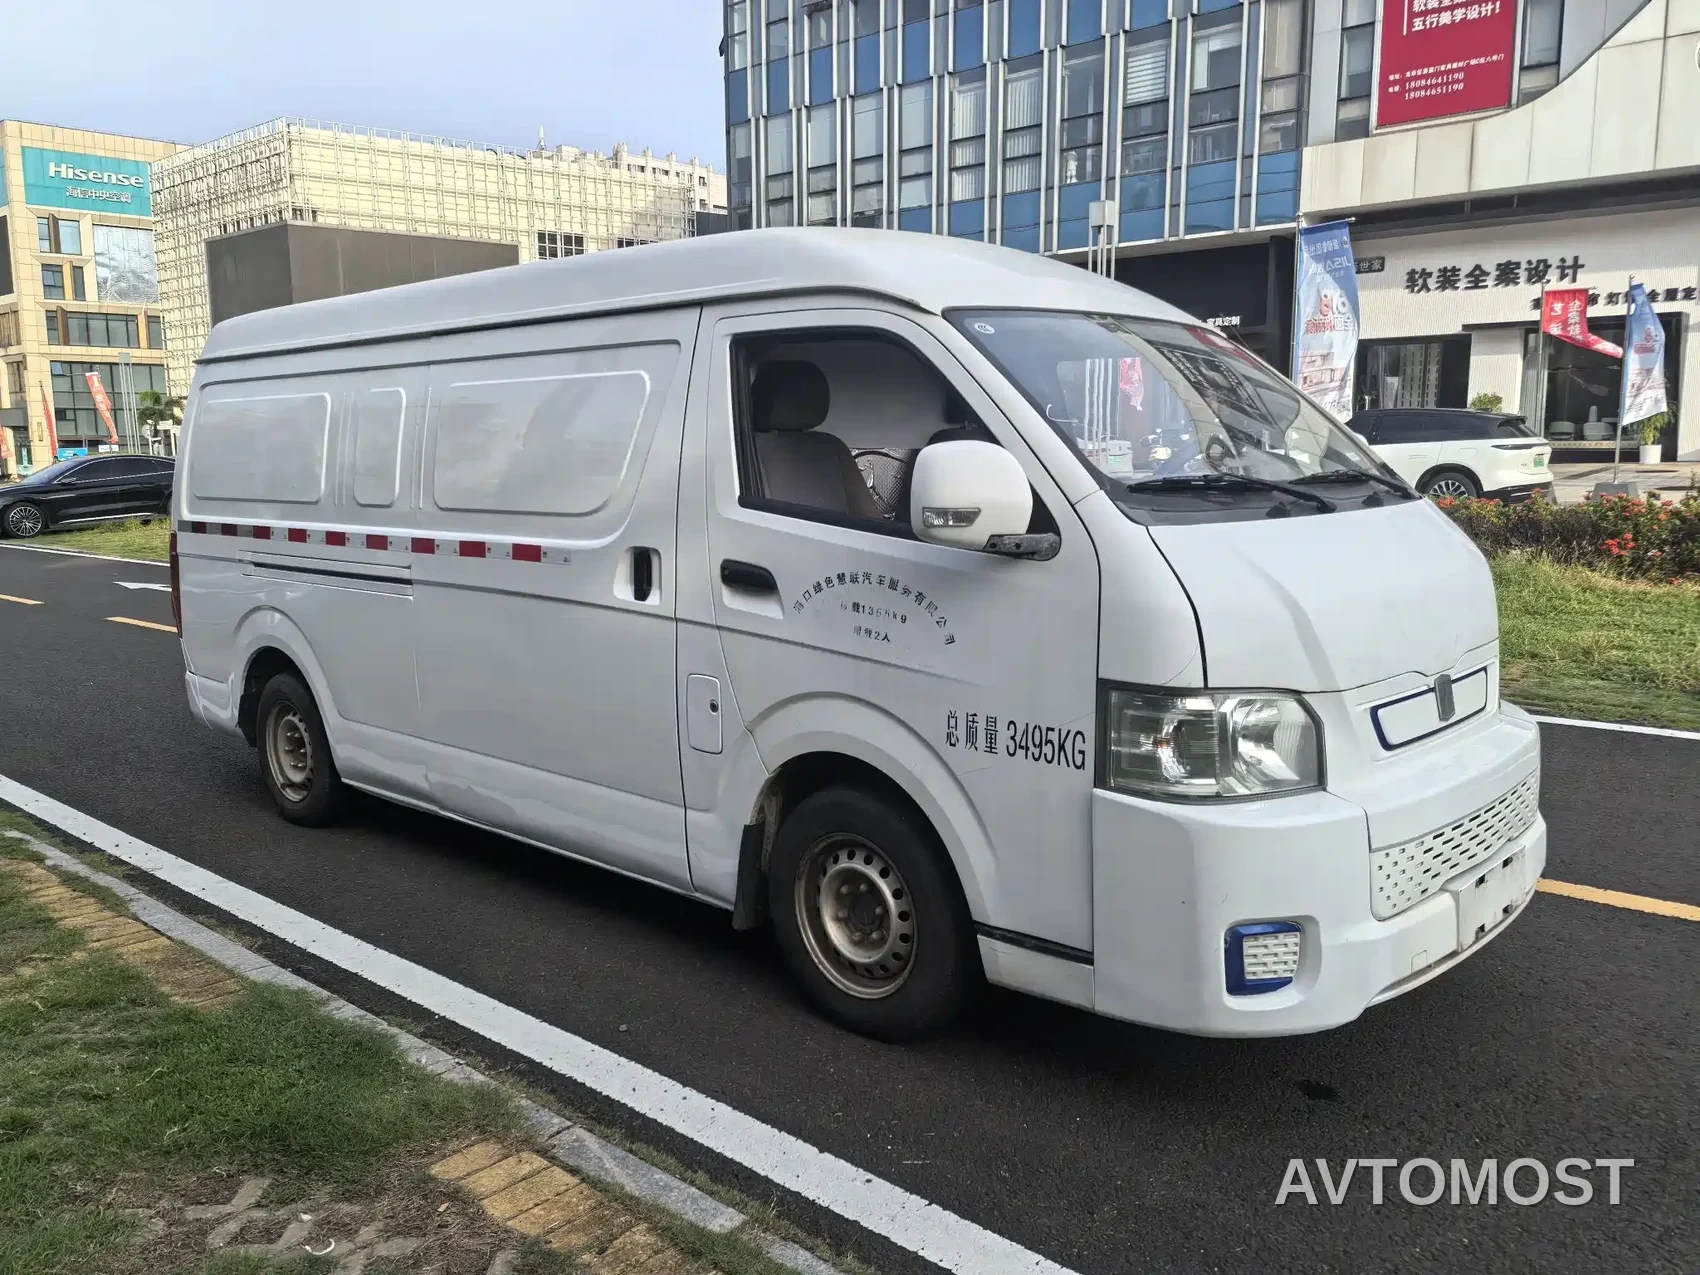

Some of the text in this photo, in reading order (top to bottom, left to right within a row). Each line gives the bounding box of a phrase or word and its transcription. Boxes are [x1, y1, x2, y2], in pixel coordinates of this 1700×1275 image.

[49, 162, 144, 188] Hisense
[1354, 259, 1382, 271] 世家
[1405, 256, 1584, 294] 软装全案设计
[945, 709, 1086, 770] 总质量 3495KG
